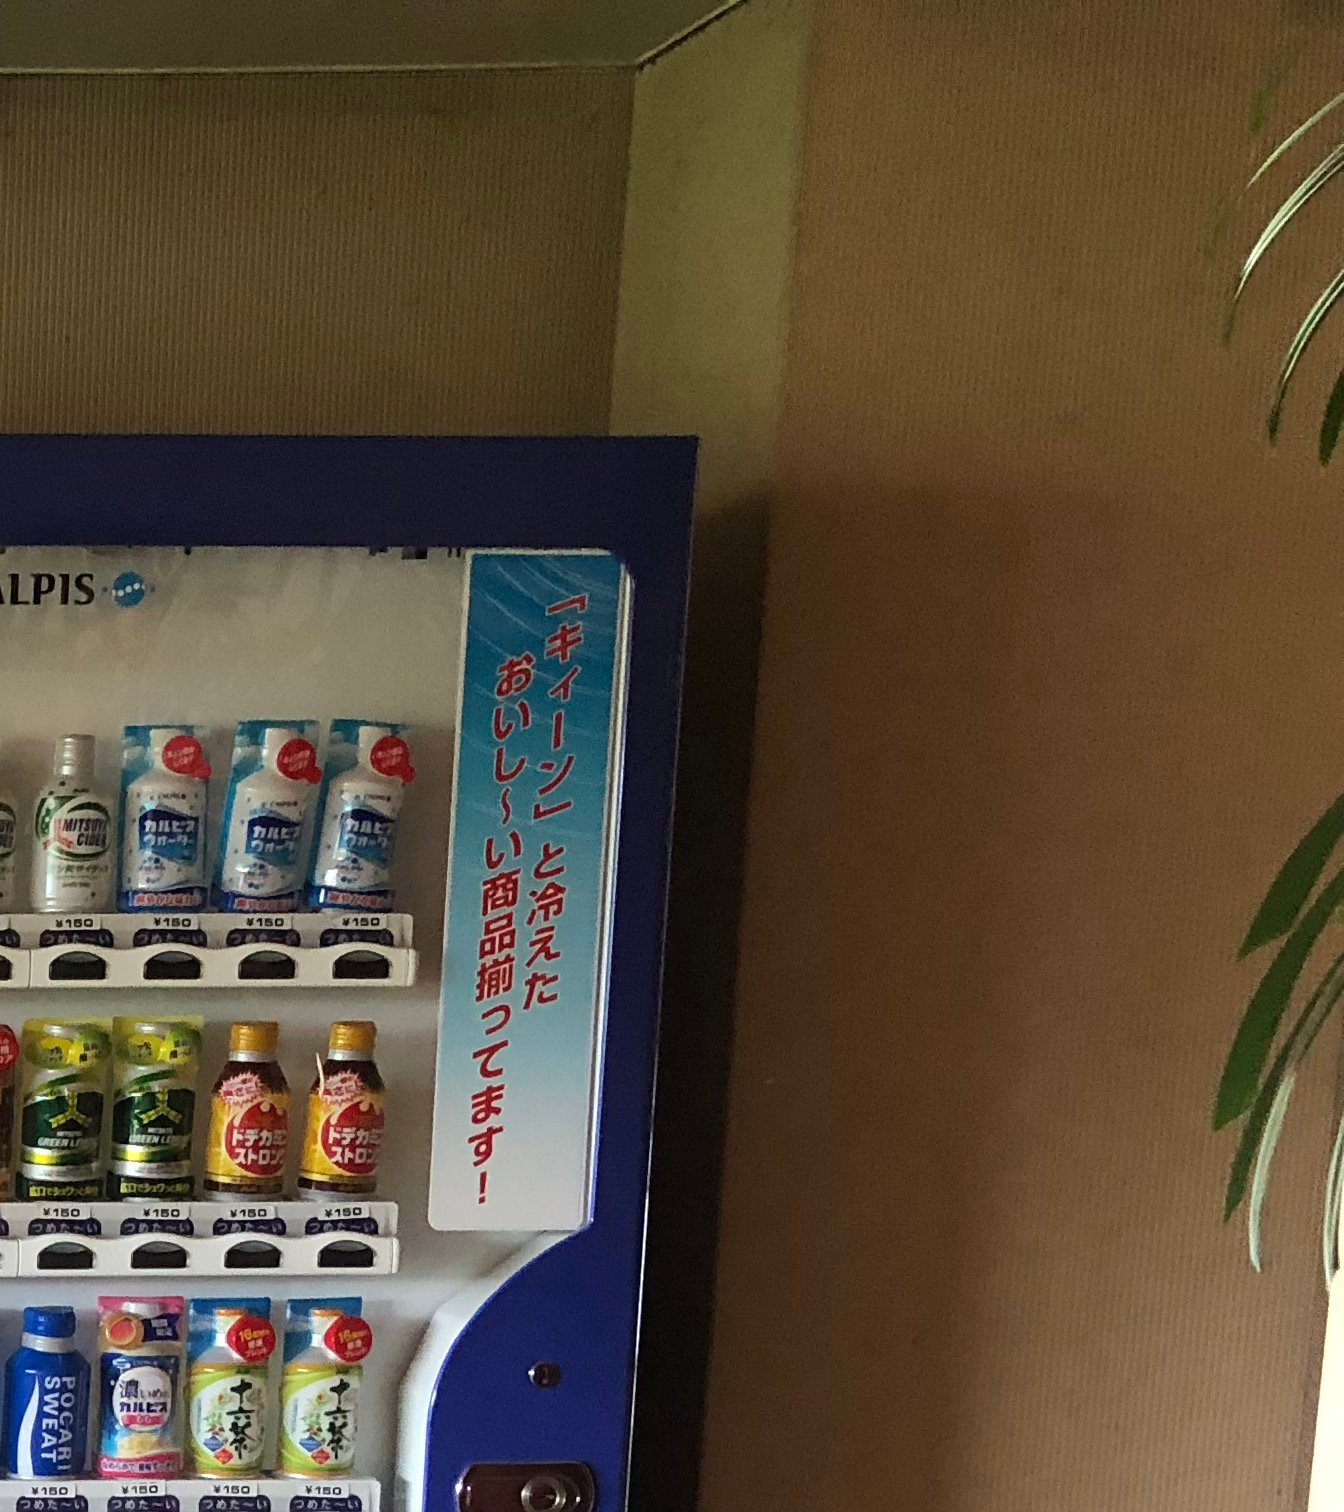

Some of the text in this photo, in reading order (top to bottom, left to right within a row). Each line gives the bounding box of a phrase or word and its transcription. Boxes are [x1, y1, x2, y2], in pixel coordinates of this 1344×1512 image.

[143, 819, 199, 835] カルピス
[143, 835, 197, 849] ウォーター
[56, 918, 94, 928] ¥150
[246, 917, 285, 927] ¥150
[43, 1208, 80, 1218] ¥150
[230, 1208, 267, 1218] ¥150
[41, 1375, 61, 1464] SWEAT
[58, 1375, 77, 1472] POCARI
[225, 1378, 256, 1460] 十六茶
[323, 1378, 352, 1461] 十六茶
[32, 1487, 68, 1495] ¥150
[214, 1485, 250, 1494] ¥150
